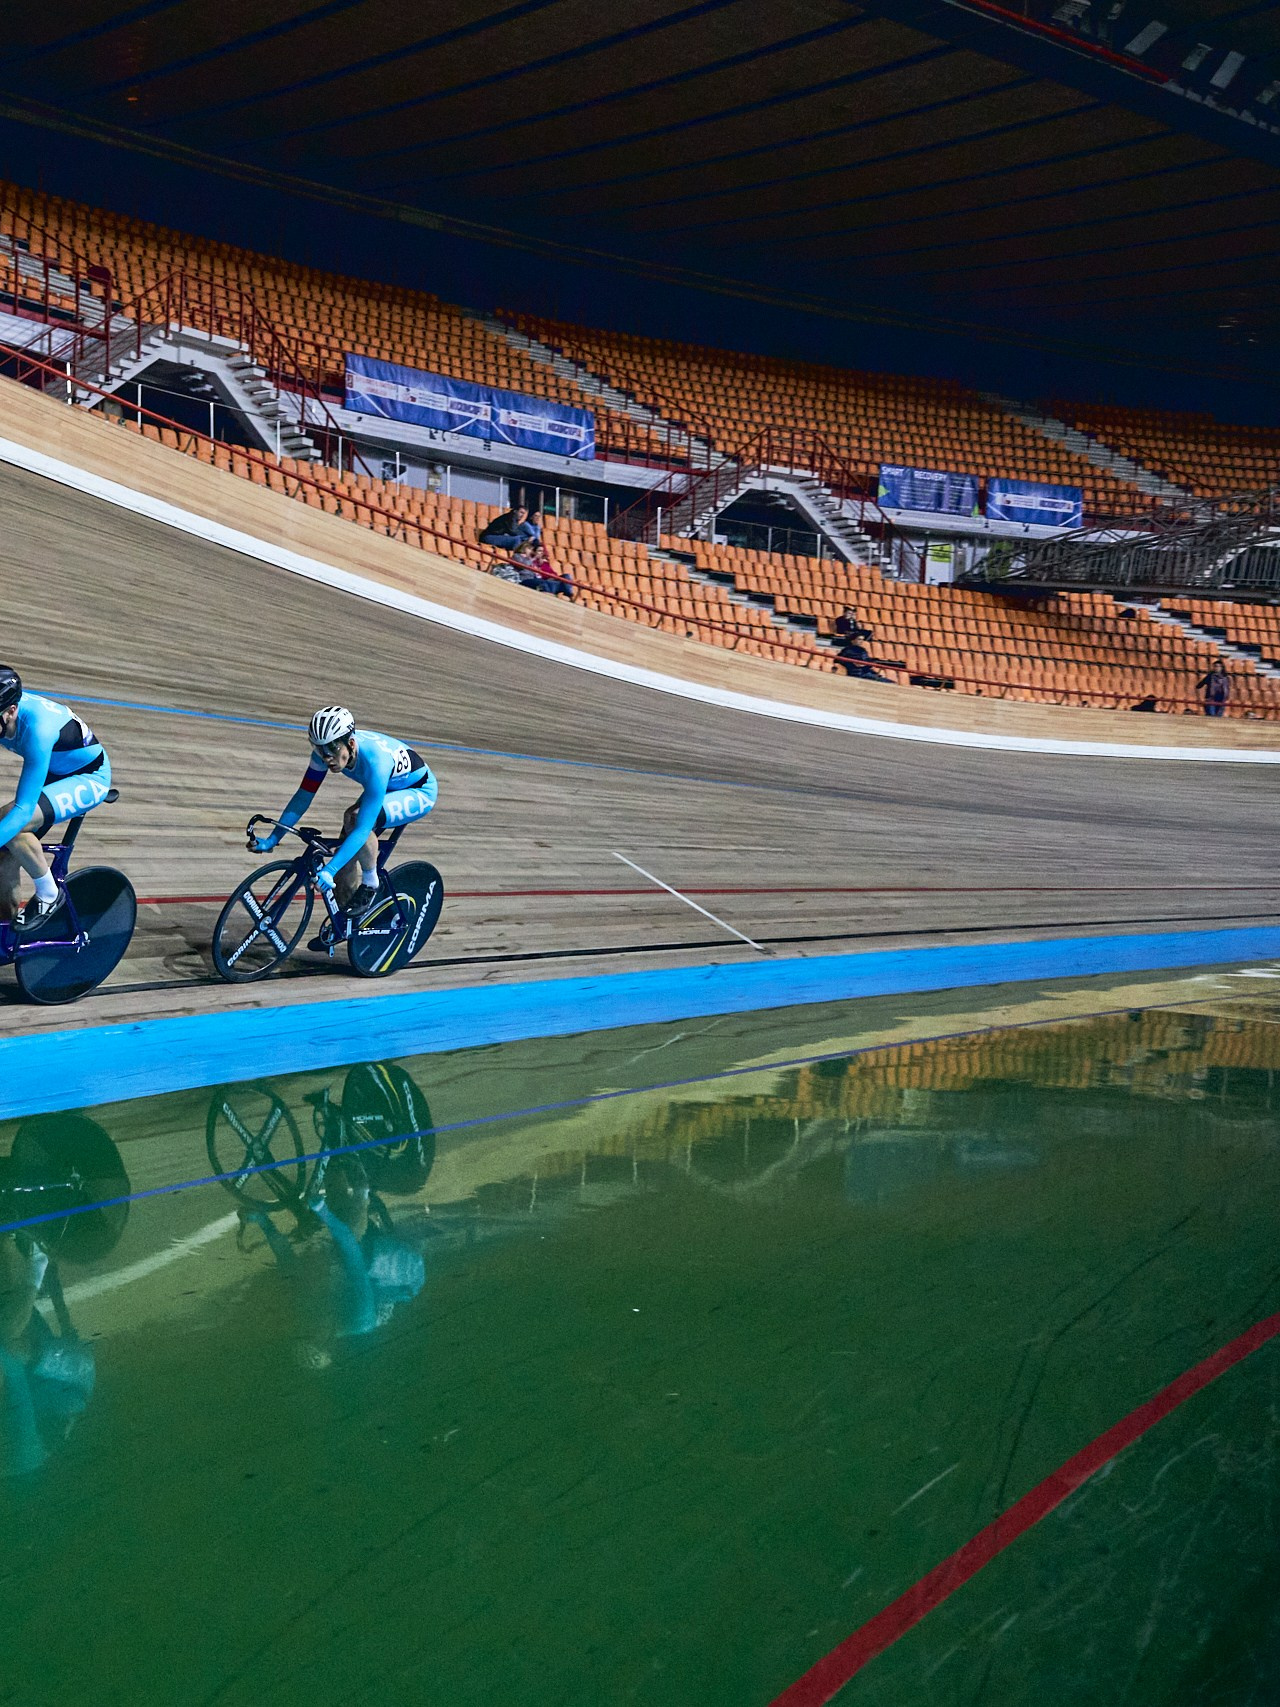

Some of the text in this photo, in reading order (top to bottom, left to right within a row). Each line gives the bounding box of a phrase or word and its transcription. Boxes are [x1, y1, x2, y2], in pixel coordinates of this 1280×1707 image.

[54, 779, 110, 818] RCA
[386, 792, 436, 823] RCA
[243, 891, 264, 919] CORIMA
[407, 880, 437, 954] CORIMA
[227, 930, 259, 967] CORIMA
